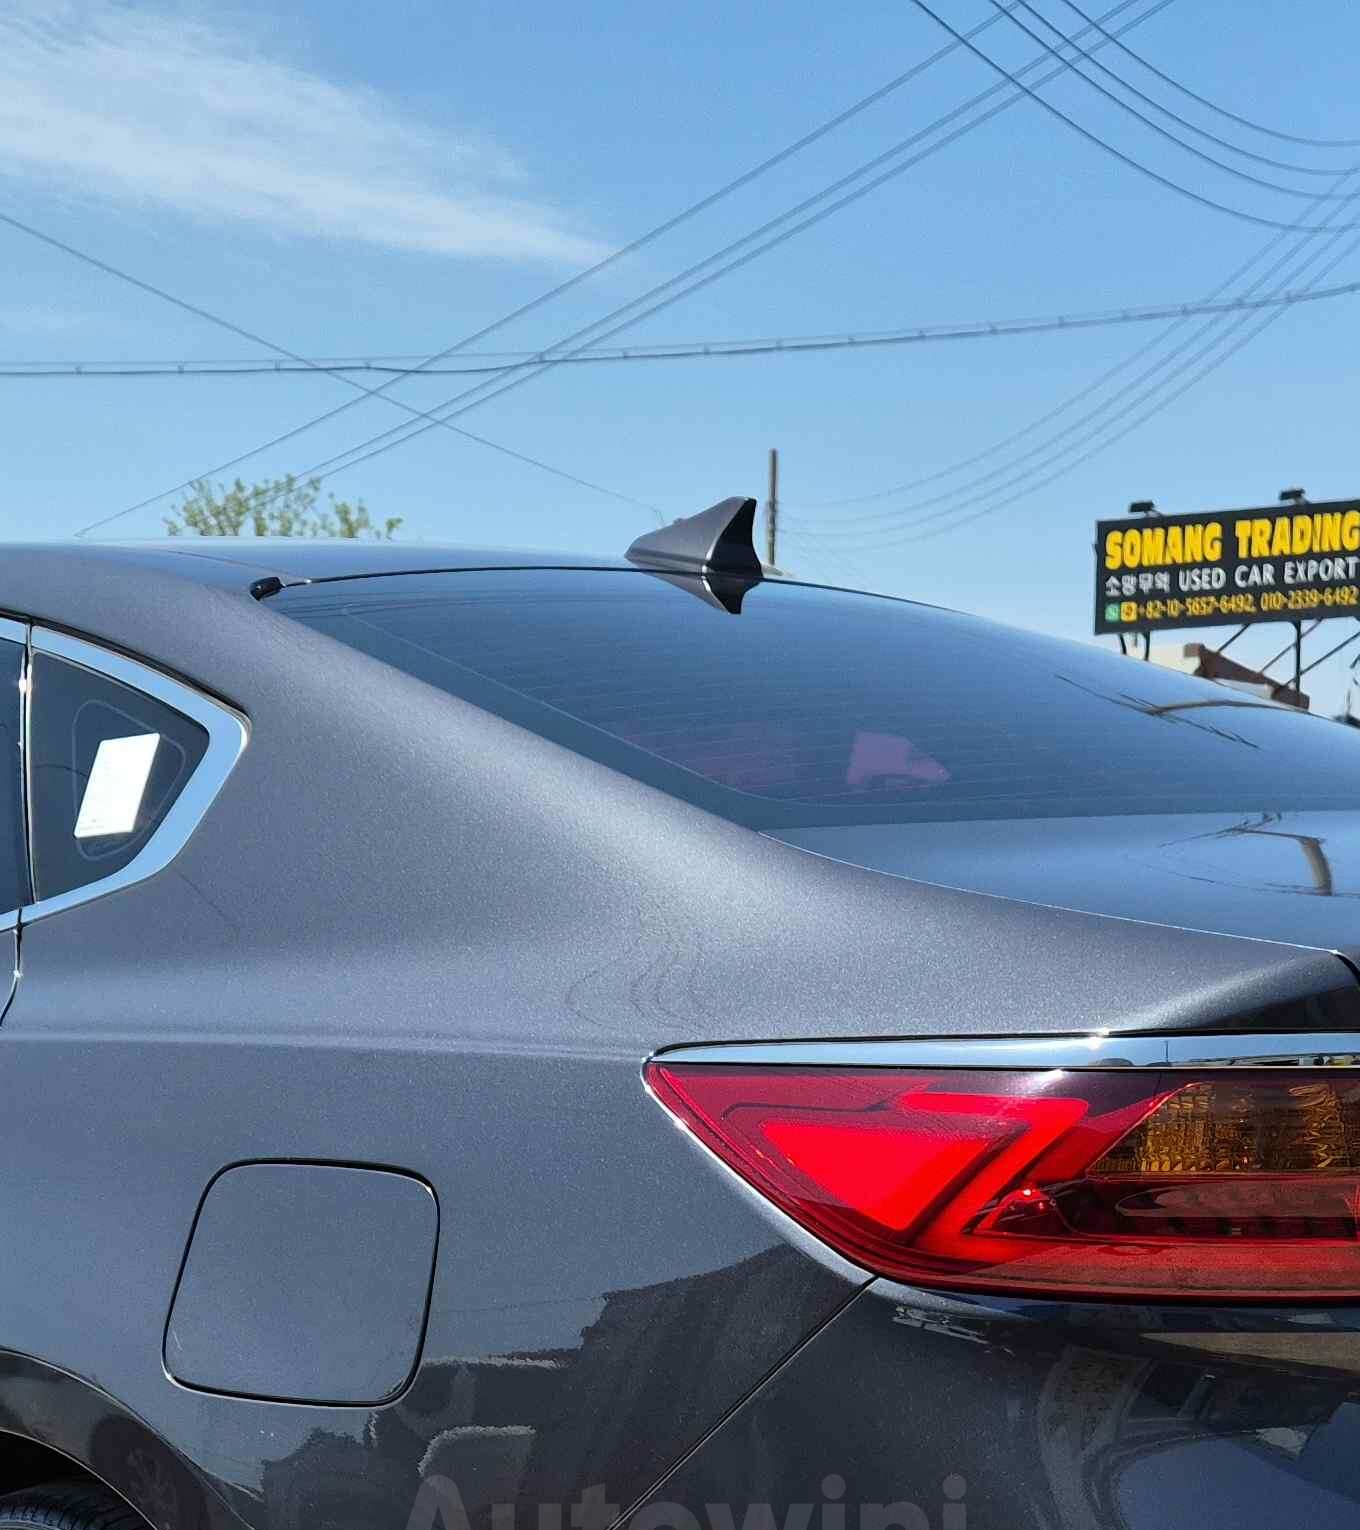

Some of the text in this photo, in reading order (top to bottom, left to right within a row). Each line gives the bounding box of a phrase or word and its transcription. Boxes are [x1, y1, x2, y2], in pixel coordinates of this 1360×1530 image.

[1105, 522, 1223, 570] SOMANG
[1178, 566, 1226, 592] USED
[1234, 564, 1276, 588] CAR
[1283, 556, 1360, 584] EXPORT
